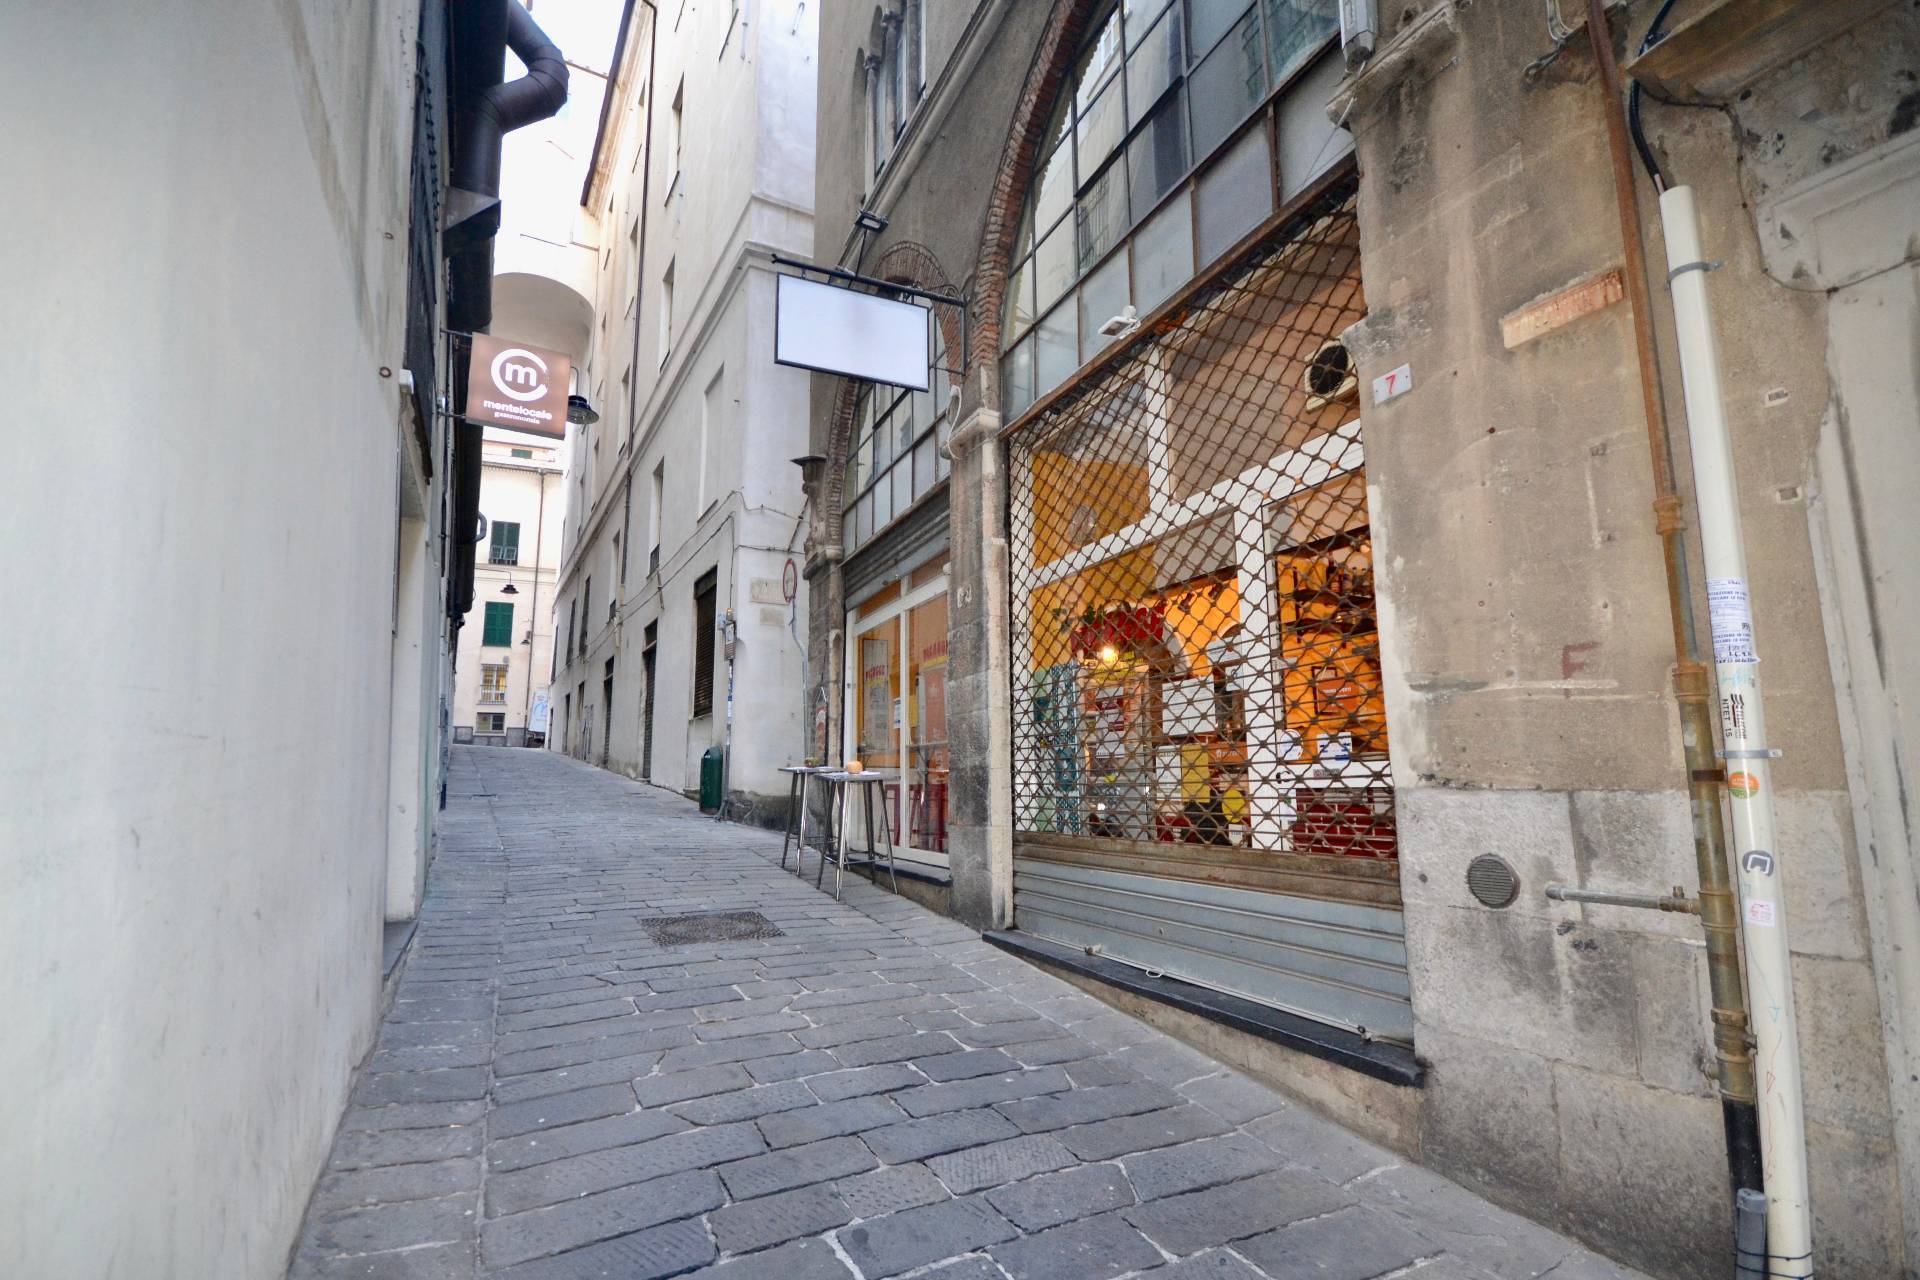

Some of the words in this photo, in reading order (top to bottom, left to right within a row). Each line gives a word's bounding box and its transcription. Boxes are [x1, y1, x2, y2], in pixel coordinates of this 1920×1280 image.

[505, 362, 537, 387] m
[1385, 372, 1397, 396] 7
[483, 399, 553, 421] mentelocale
